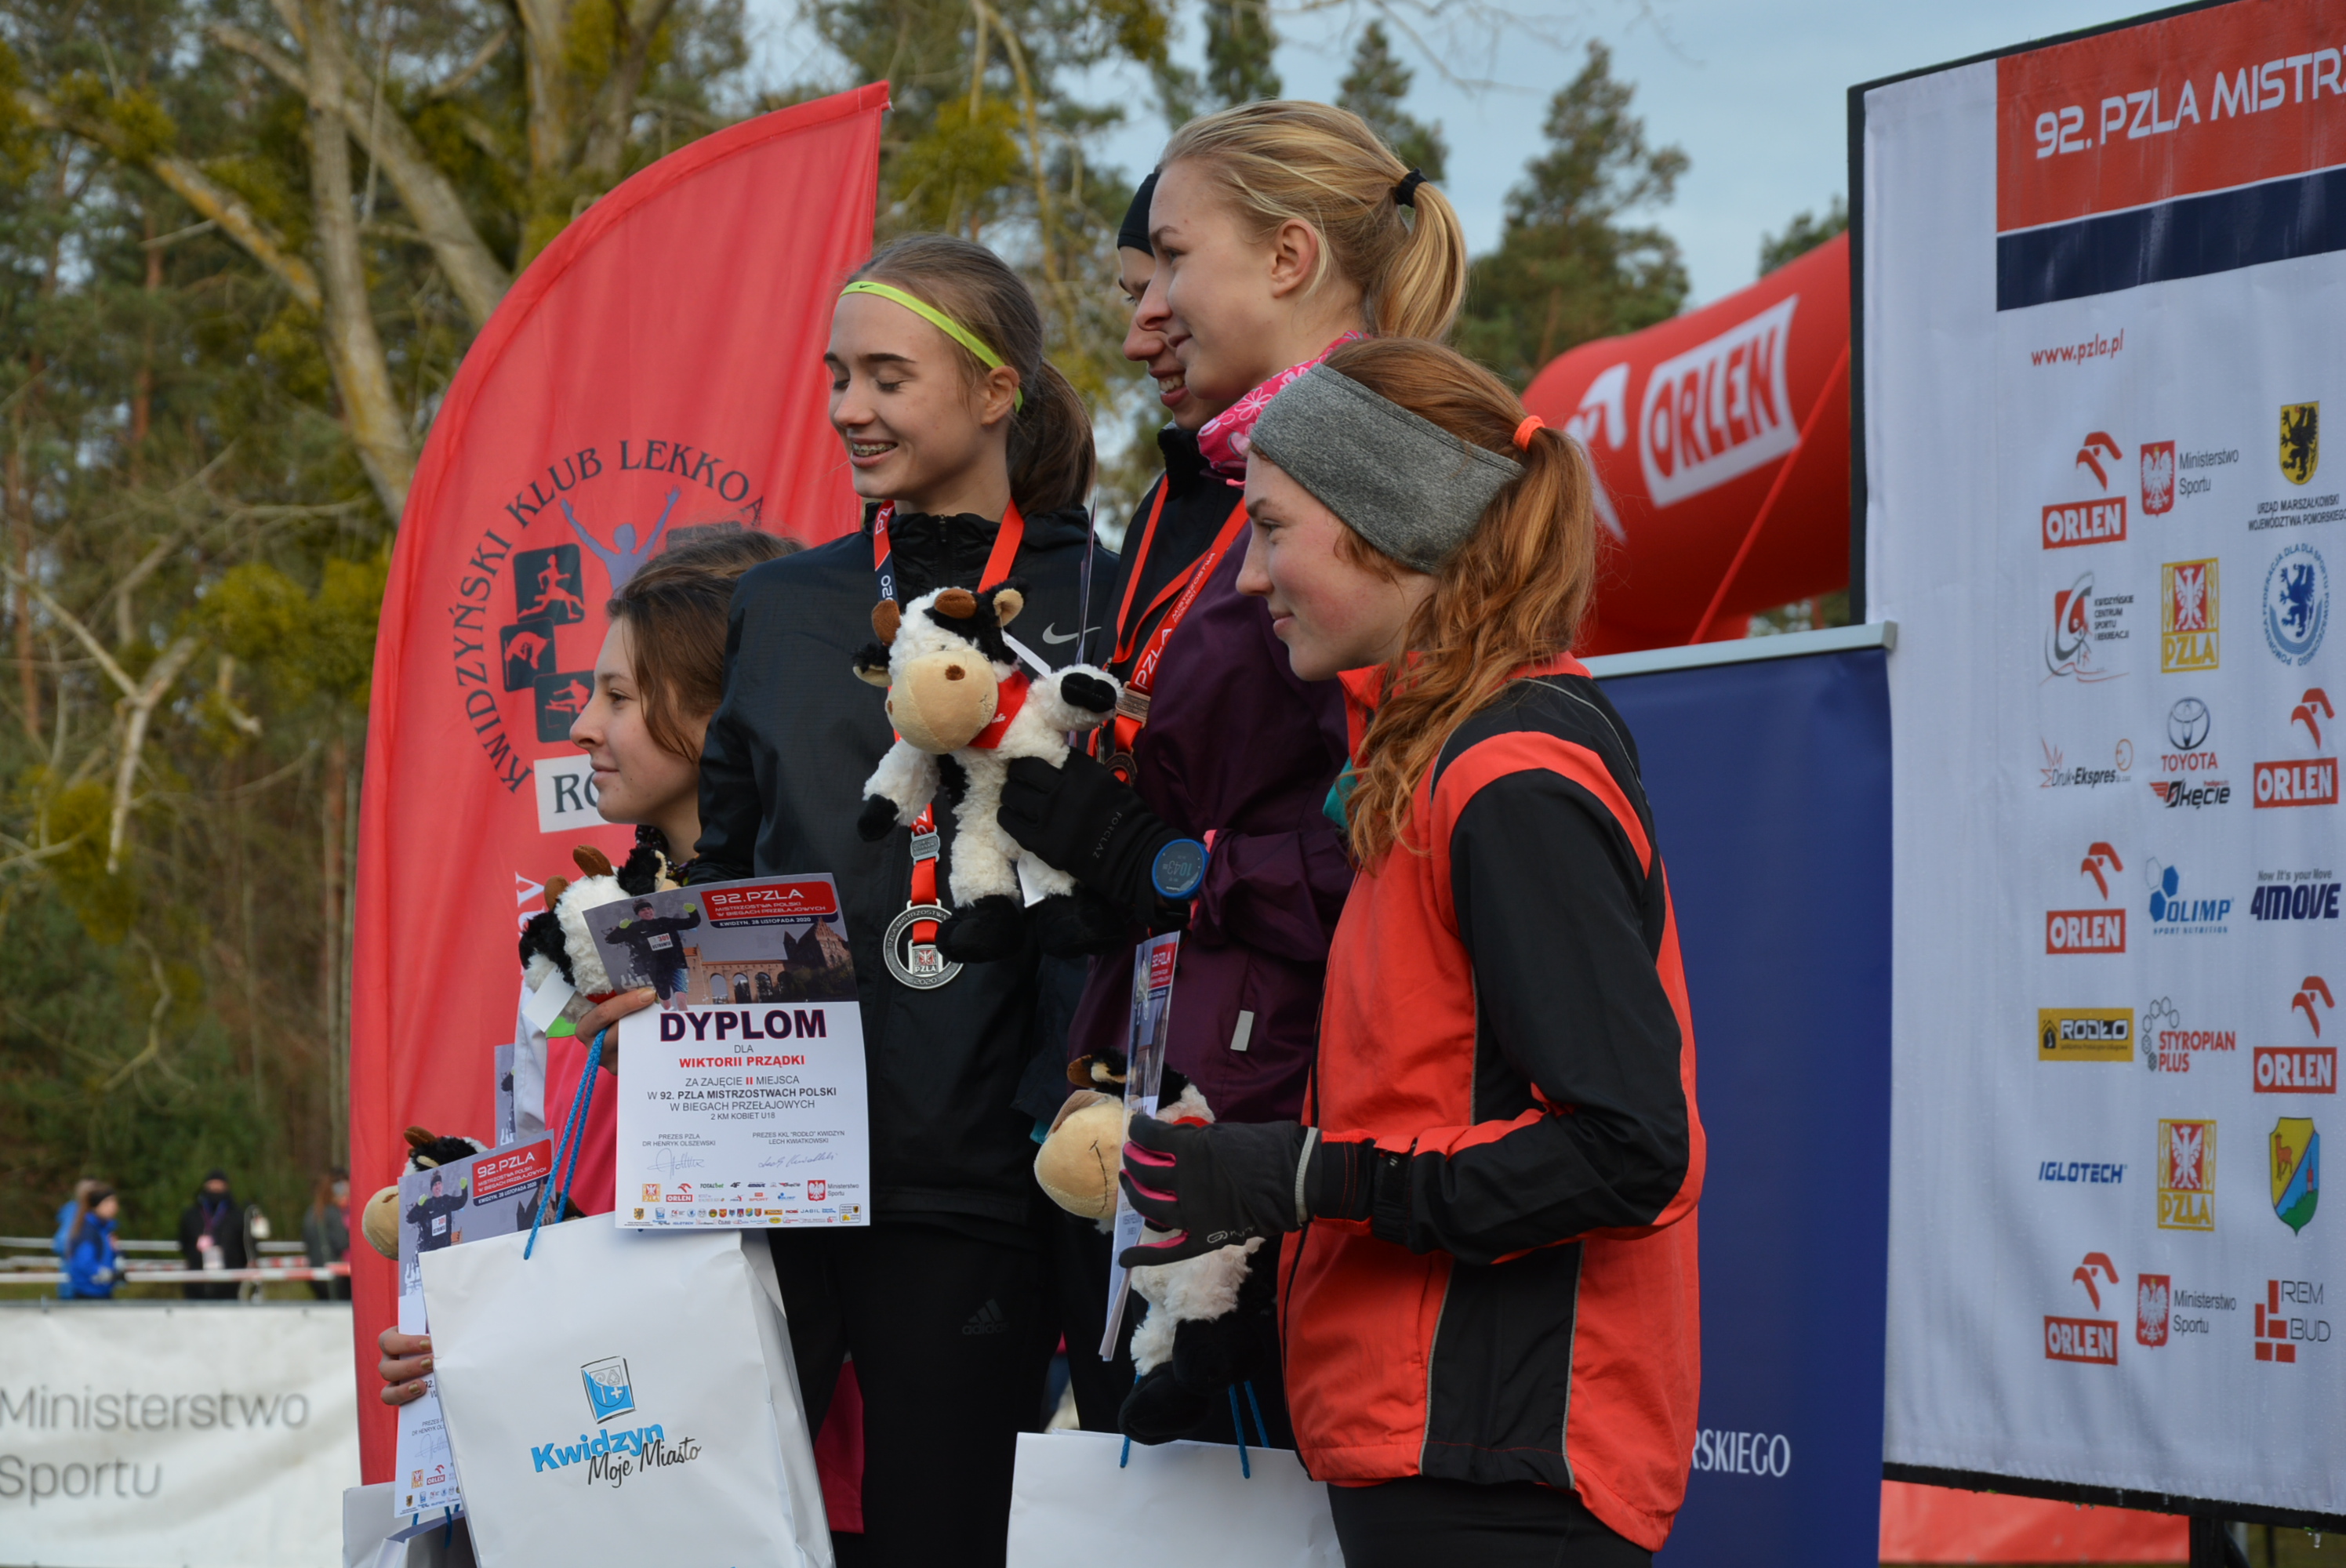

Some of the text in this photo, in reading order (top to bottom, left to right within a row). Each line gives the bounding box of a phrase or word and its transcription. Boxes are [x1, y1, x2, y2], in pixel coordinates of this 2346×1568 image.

[2100, 78, 2201, 145] PZLA
[2210, 44, 2346, 122] MISTR
[2032, 328, 2123, 366] www.pzla.pl
[1651, 325, 1779, 481] ORLEN
[2179, 448, 2239, 470] Ministerstwo
[2179, 477, 2211, 497] Sportu
[2046, 504, 2121, 543] ORLEN
[1172, 553, 1215, 618] MISTRZOSTWA
[448, 439, 764, 794] KWIDZYŃSKI KLUB LEKKOA
[1174, 590, 1197, 623] POLSKI
[1135, 628, 1172, 690] PZLA
[2163, 633, 2217, 667] PZLA
[2161, 752, 2218, 772] TOYOTA
[2257, 766, 2333, 803] ORLEN
[2258, 868, 2332, 883] Now It's your Move
[715, 903, 772, 912] MISTRZOSTWA
[2166, 899, 2231, 922] OLIMP
[2250, 883, 2341, 920] 4MOVE
[2050, 916, 2120, 948] ORLEN
[2154, 926, 2228, 935] SPORT NUTRITION
[913, 977, 937, 985] 2020
[914, 964, 936, 973] PZLA
[660, 1009, 826, 1042] DYPLOM
[734, 1044, 754, 1054] DLA
[2159, 1030, 2235, 1051] STYROPIAN
[679, 1054, 805, 1068] WIKTORII PRZĄDKI
[2159, 1053, 2190, 1073] PLUS
[2257, 1053, 2332, 1087] ORLEN
[647, 1087, 837, 1100] W 92. PZLA MISTRZOSTWACH POLSKI
[685, 1075, 800, 1088] ZA ZAJĘCIE II MIEJSCA
[670, 1099, 815, 1112] W BIEGACH PRZEŁAJOWYCH
[2039, 1162, 2123, 1184] IGLOTECH
[2159, 1191, 2213, 1226] PZLA
[2174, 1290, 2237, 1311] Ministerstwo
[2282, 1280, 2324, 1305] REM
[2173, 1315, 2209, 1336] Sportu
[2290, 1319, 2331, 1342] BUD
[2047, 1322, 2114, 1359] ORLEN
[0, 1385, 310, 1432] Ministerstwo
[531, 1424, 665, 1472] Kwidzyn
[588, 1437, 701, 1488] Moje Miasto
[0, 1454, 162, 1507] Sportu
